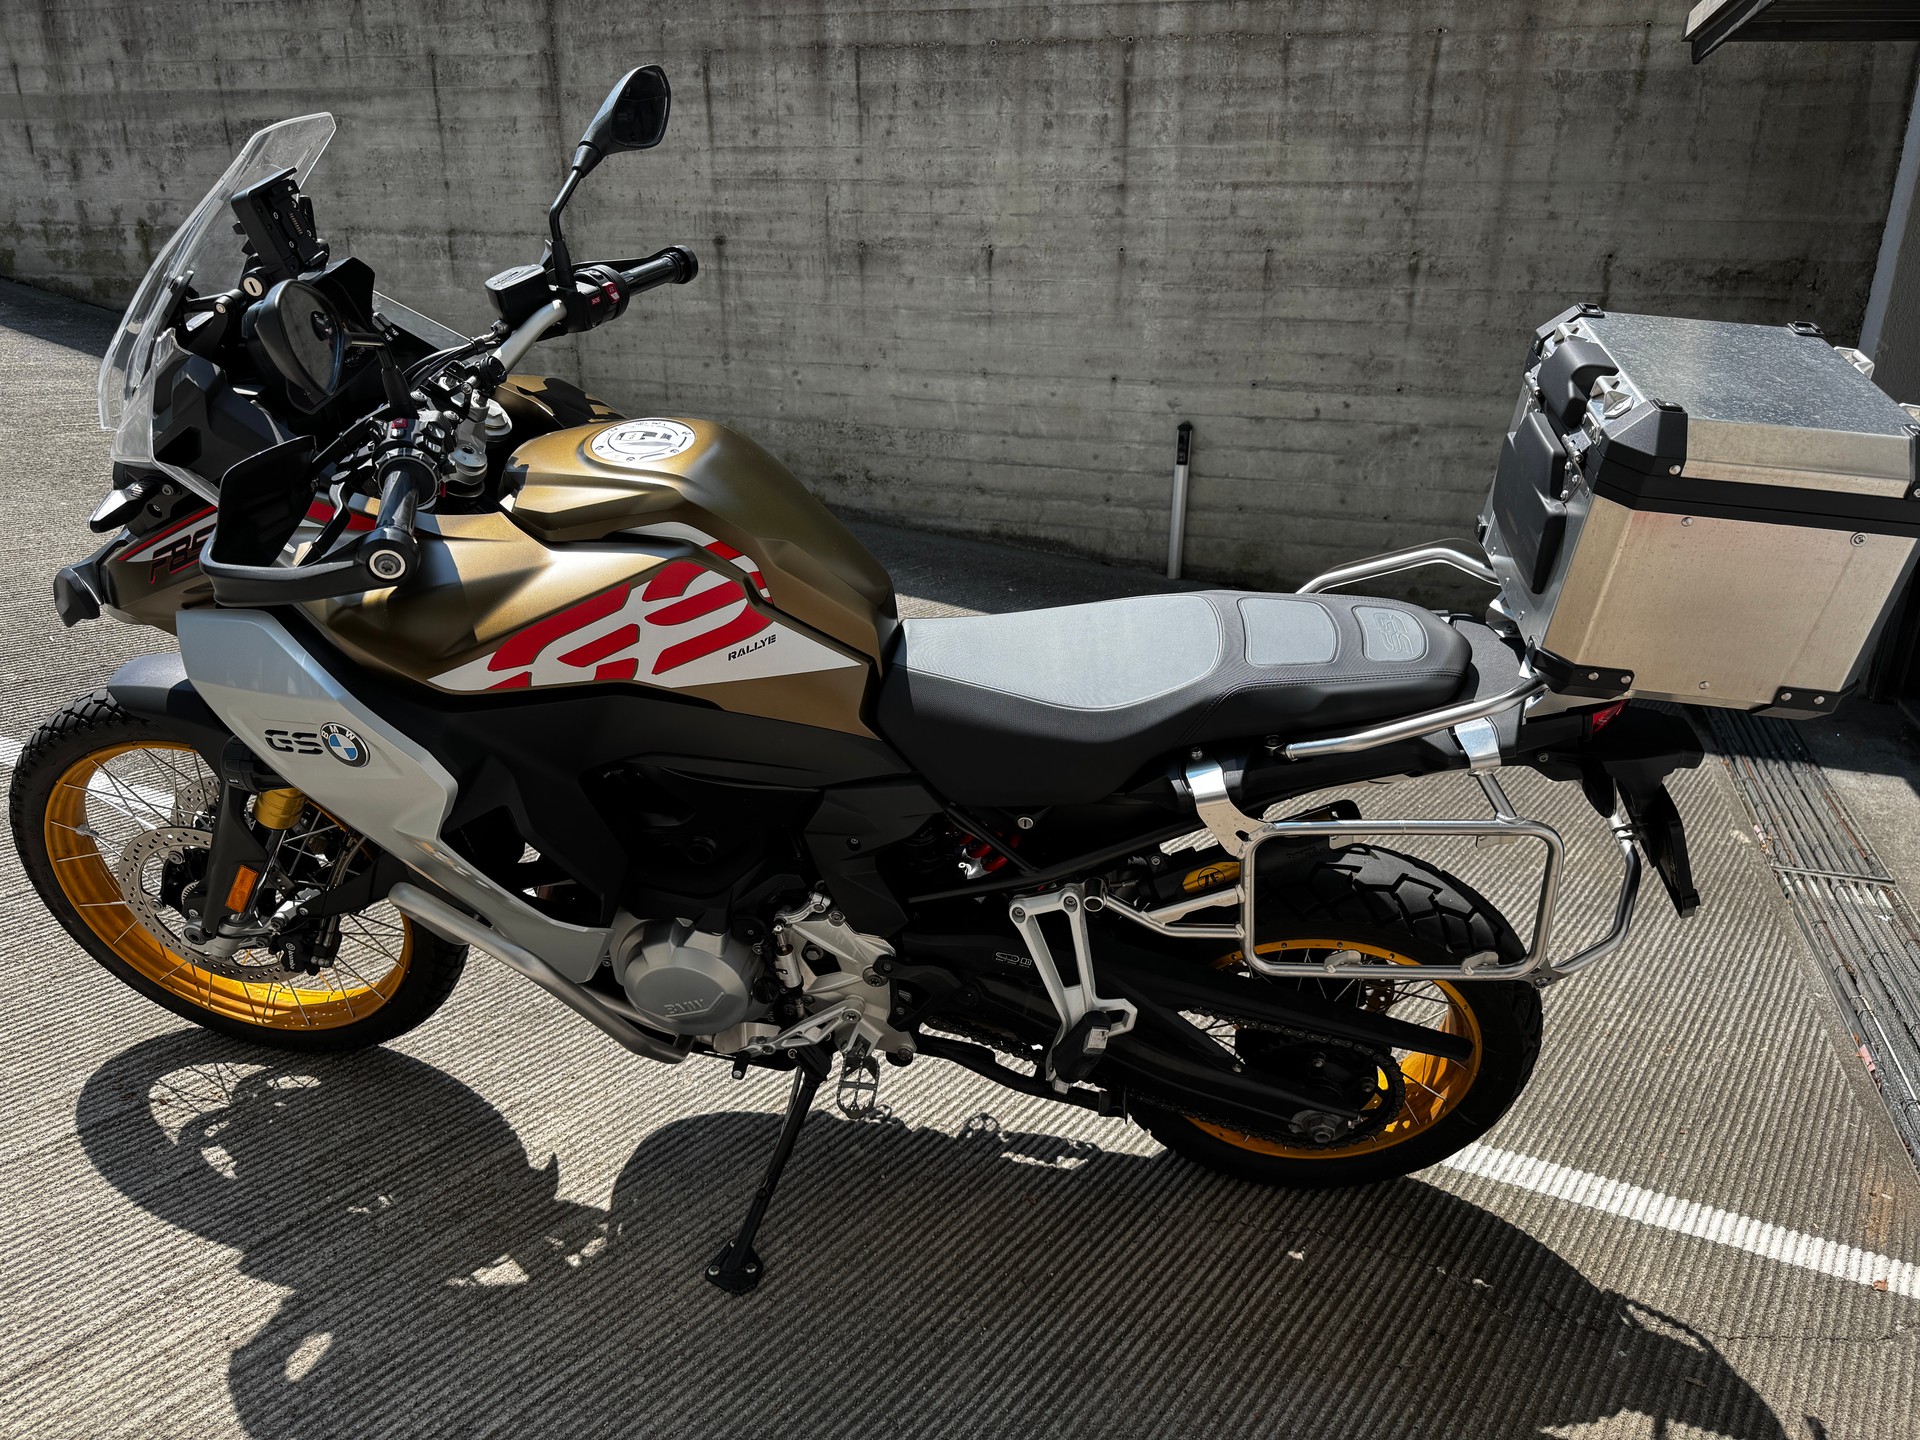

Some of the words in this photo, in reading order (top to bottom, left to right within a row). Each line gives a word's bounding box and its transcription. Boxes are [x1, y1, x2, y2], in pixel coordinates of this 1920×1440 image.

[728, 634, 776, 661] RALLYE
[264, 729, 324, 755] GS
[664, 999, 704, 1014] BMW
